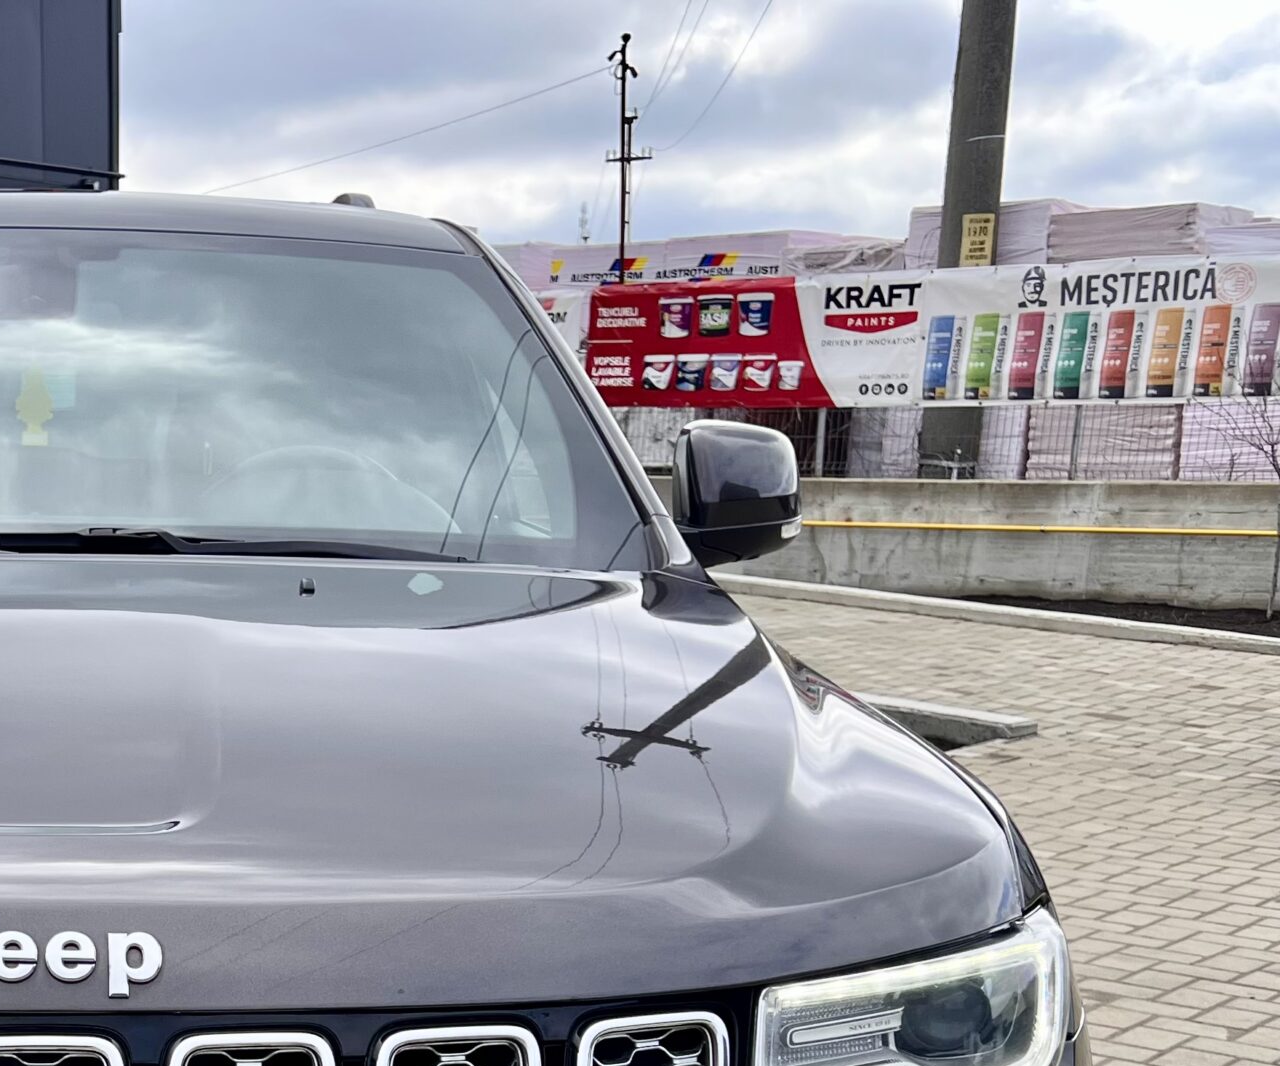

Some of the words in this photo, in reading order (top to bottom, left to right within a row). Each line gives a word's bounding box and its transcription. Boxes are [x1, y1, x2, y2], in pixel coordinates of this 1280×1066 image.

[824, 282, 922, 309] KRAFT
[846, 316, 895, 327] PAINTS
[821, 338, 851, 347] DRIVEN
[865, 336, 916, 346] INNOVATION
